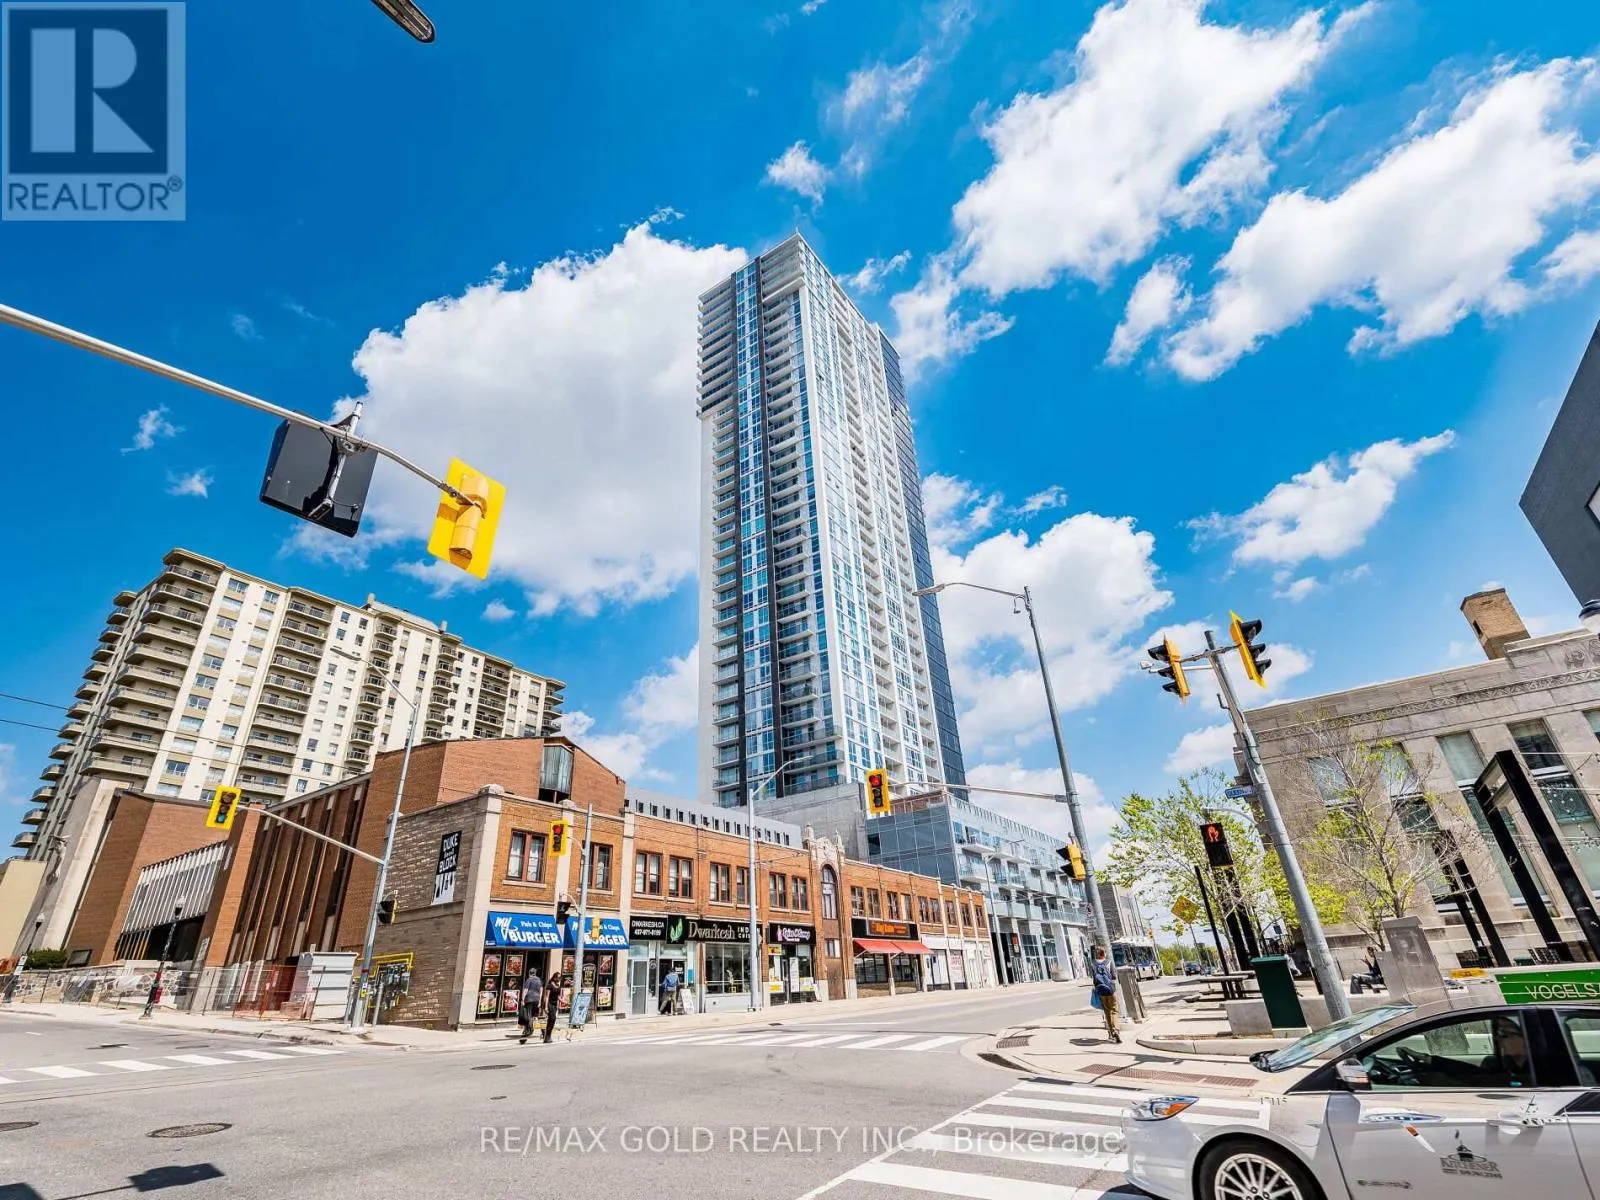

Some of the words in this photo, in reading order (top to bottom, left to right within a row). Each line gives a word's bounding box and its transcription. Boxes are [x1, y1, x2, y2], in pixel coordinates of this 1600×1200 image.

[508, 930, 561, 944] BURGER
[688, 921, 735, 939] Dwarkesh
[737, 926, 761, 934] INDN
[1525, 982, 1600, 1000] VOGELS
